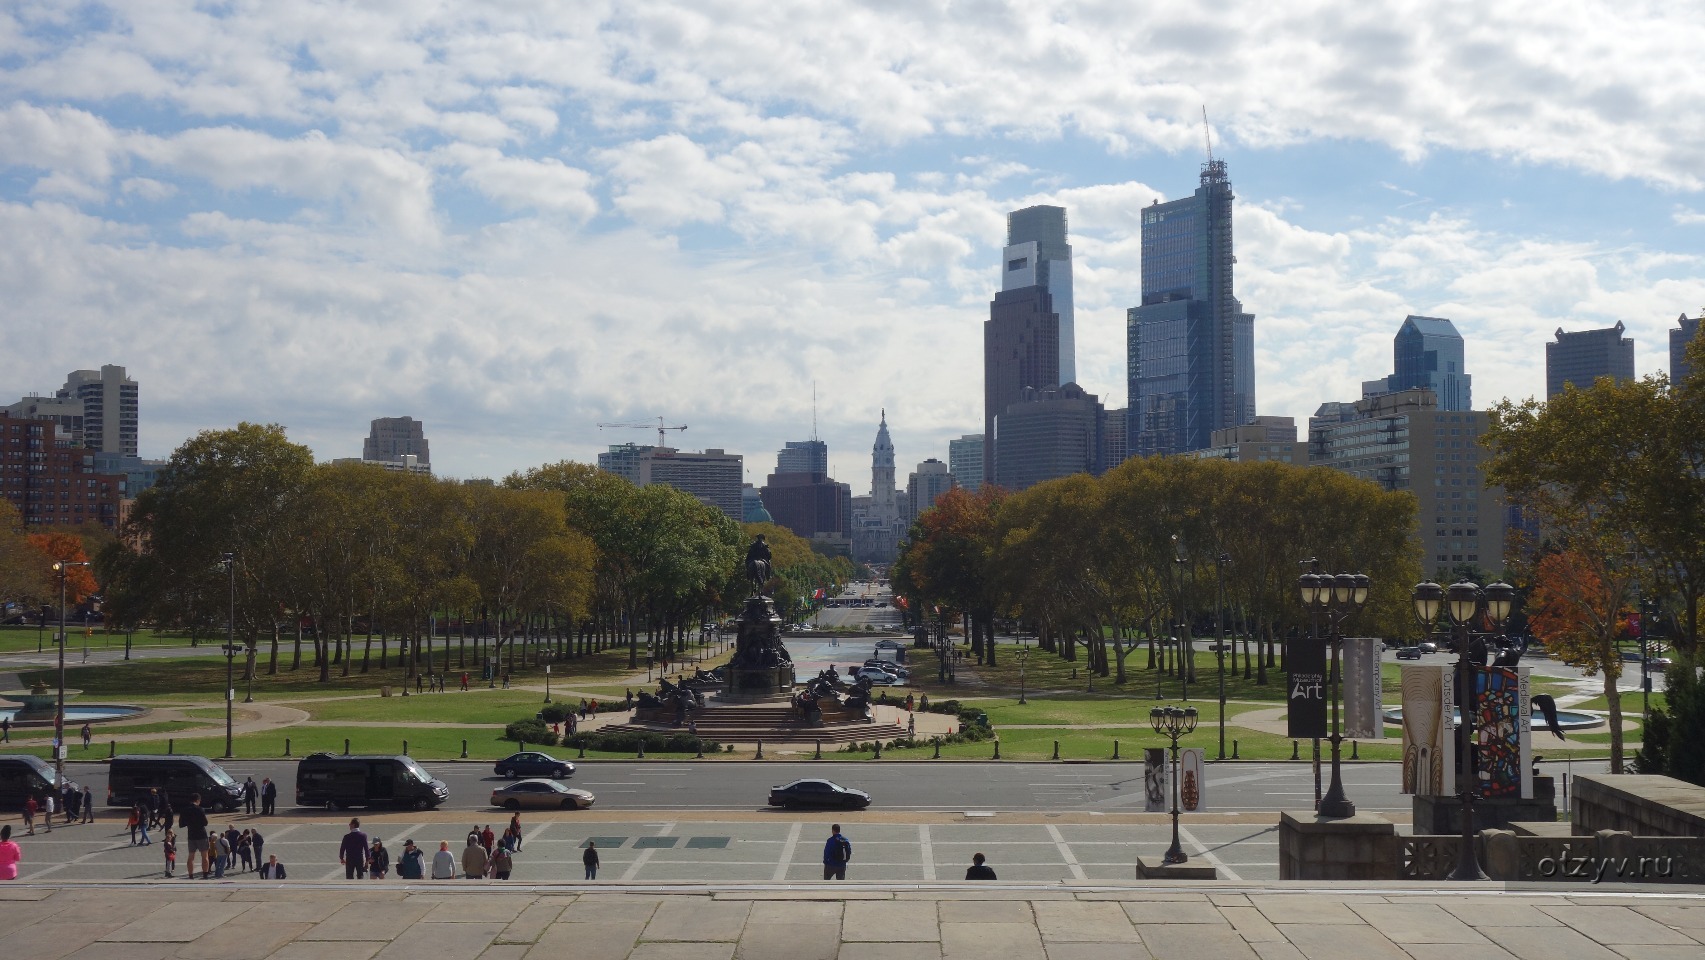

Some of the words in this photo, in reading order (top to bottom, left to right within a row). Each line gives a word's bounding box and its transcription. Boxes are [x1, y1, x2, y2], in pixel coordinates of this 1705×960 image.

[1373, 644, 1381, 697] Contemporary
[1291, 682, 1323, 700] Art
[1443, 673, 1453, 714] Outsider
[1520, 674, 1530, 717] Medieval
[1444, 716, 1453, 731] Art
[1520, 720, 1530, 733] Art
